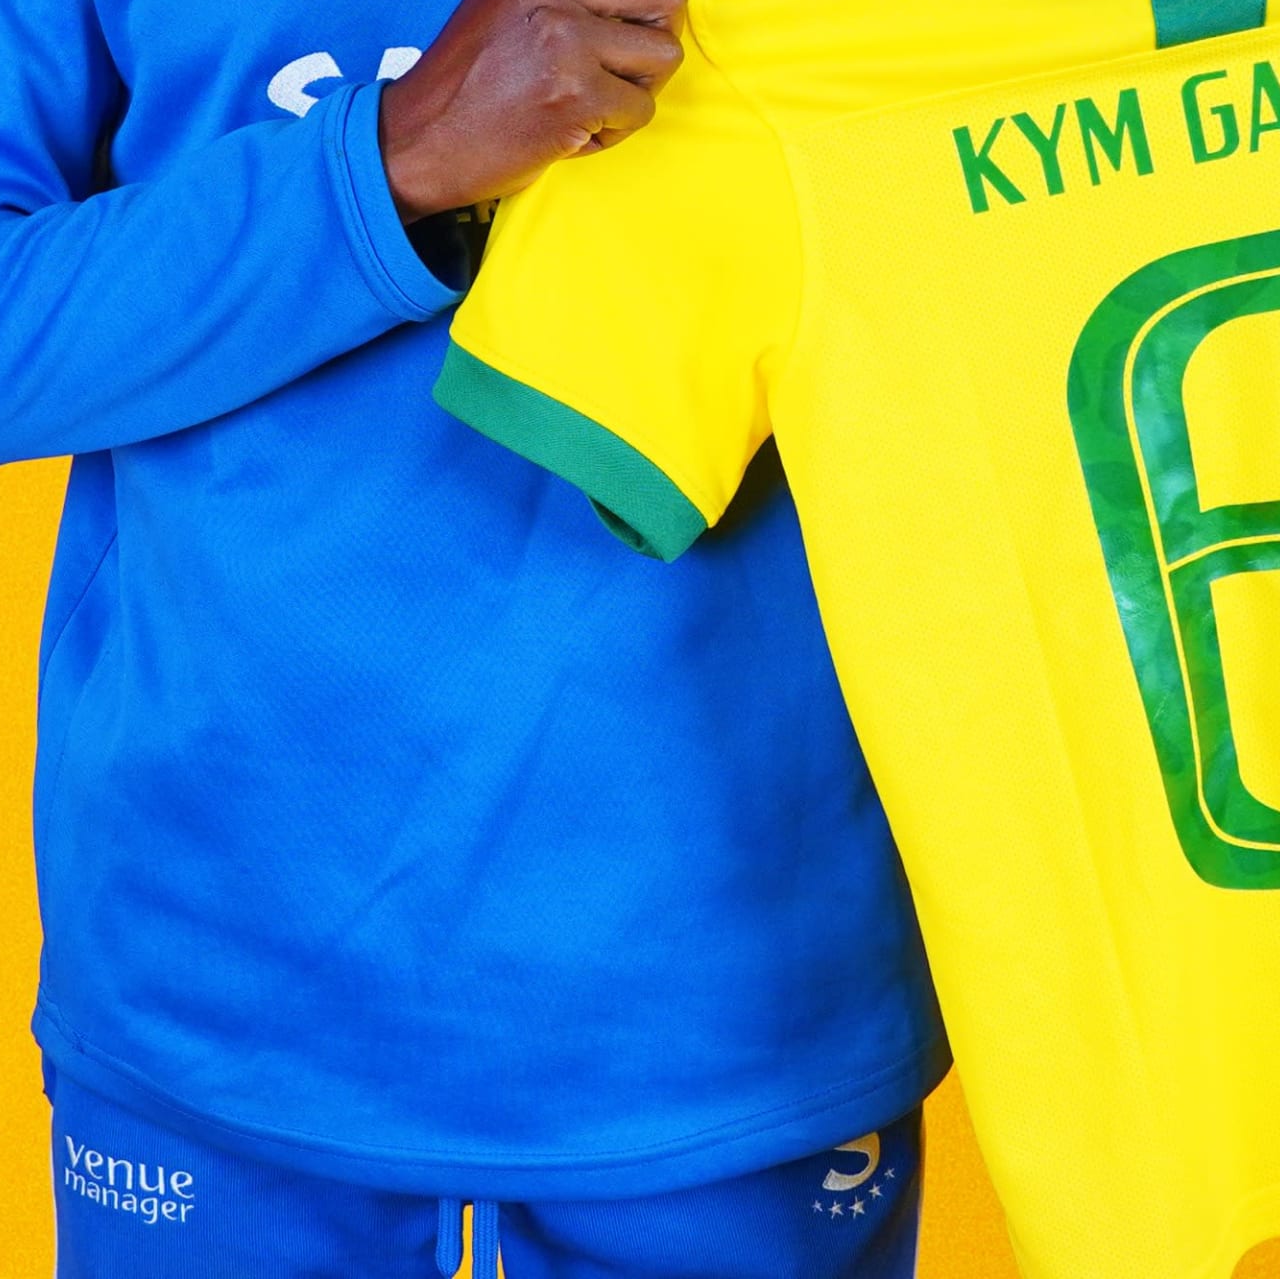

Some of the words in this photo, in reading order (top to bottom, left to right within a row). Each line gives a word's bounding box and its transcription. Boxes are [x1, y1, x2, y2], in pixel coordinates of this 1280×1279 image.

[952, 87, 1154, 214] KYM
[65, 1135, 195, 1199] venue
[65, 1167, 195, 1224] manager
